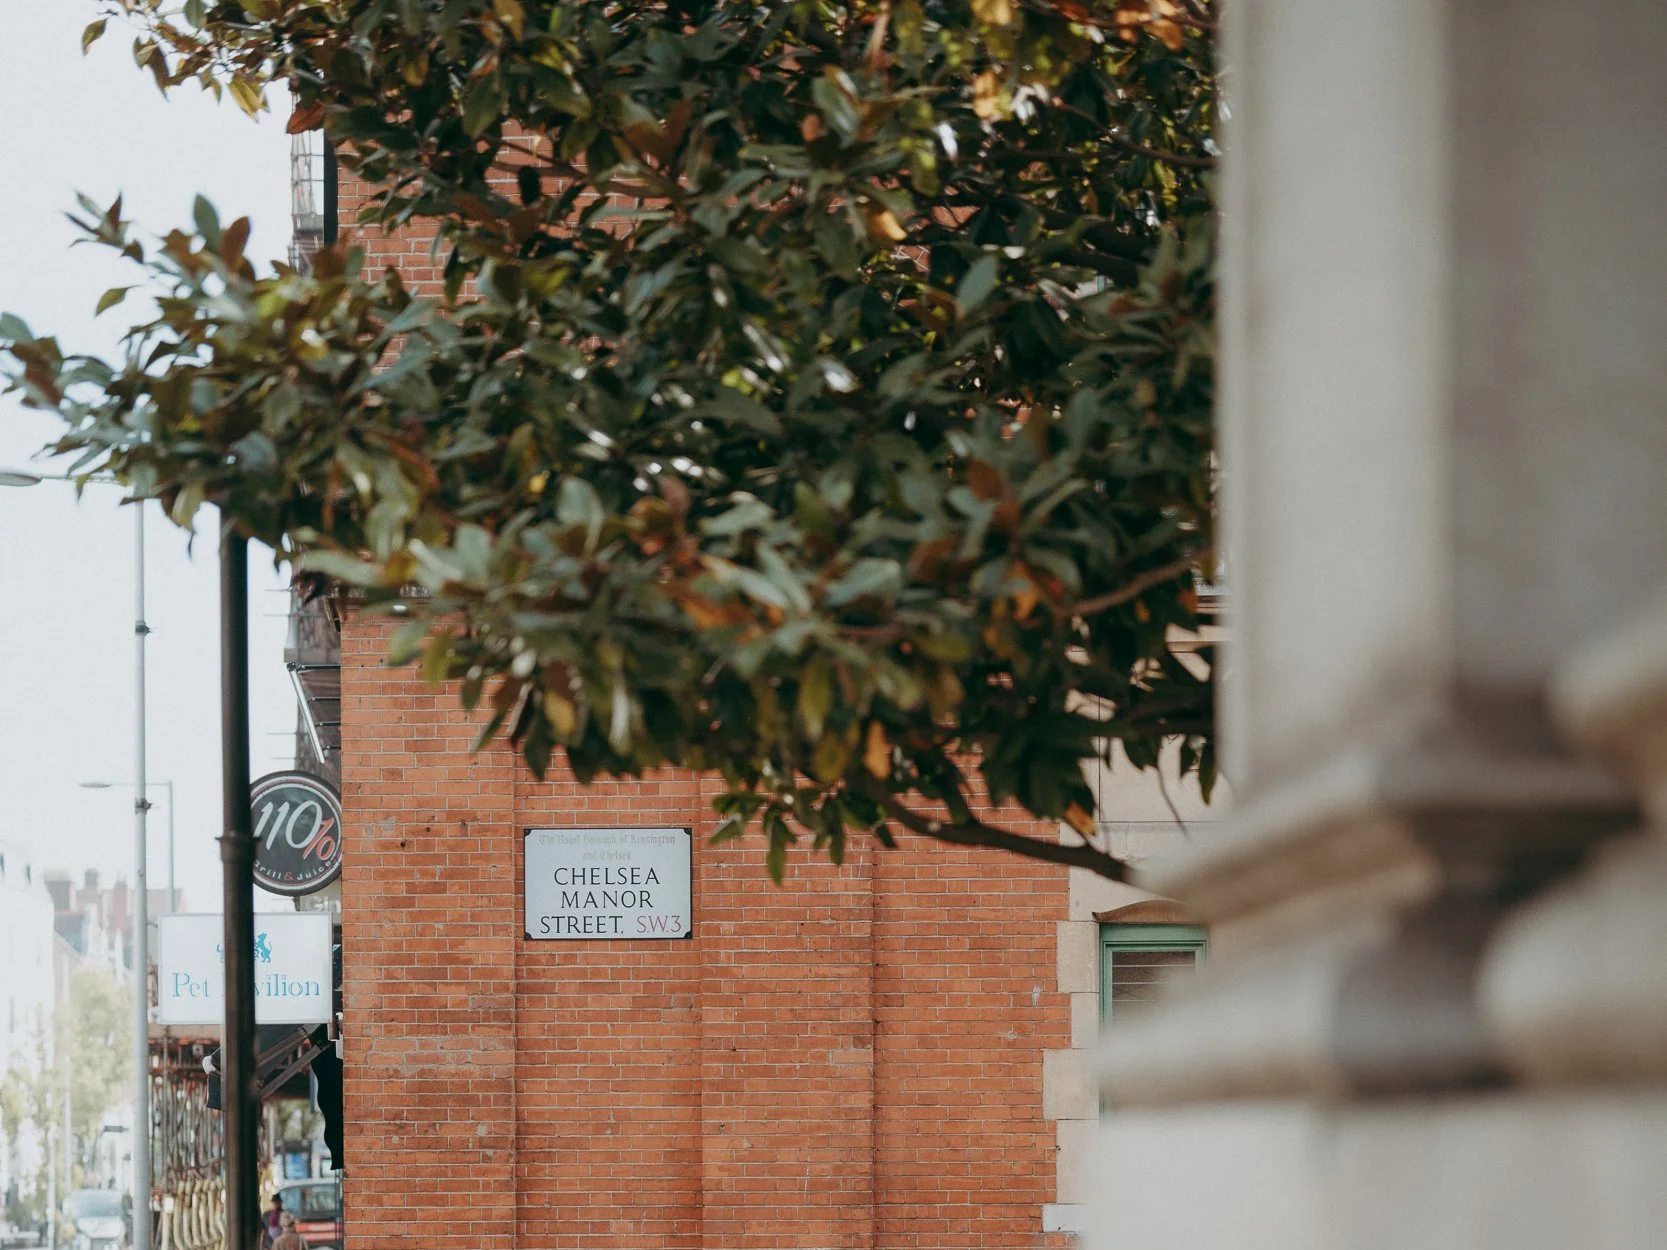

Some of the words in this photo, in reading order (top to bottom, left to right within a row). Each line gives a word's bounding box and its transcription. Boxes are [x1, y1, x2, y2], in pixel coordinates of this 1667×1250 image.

[284, 872, 294, 881] &
[554, 867, 660, 885] CHELSEA
[561, 890, 654, 908] MANOR
[636, 915, 683, 933] S.W.3
[172, 972, 209, 997] Pet
[223, 974, 320, 997] vilion
